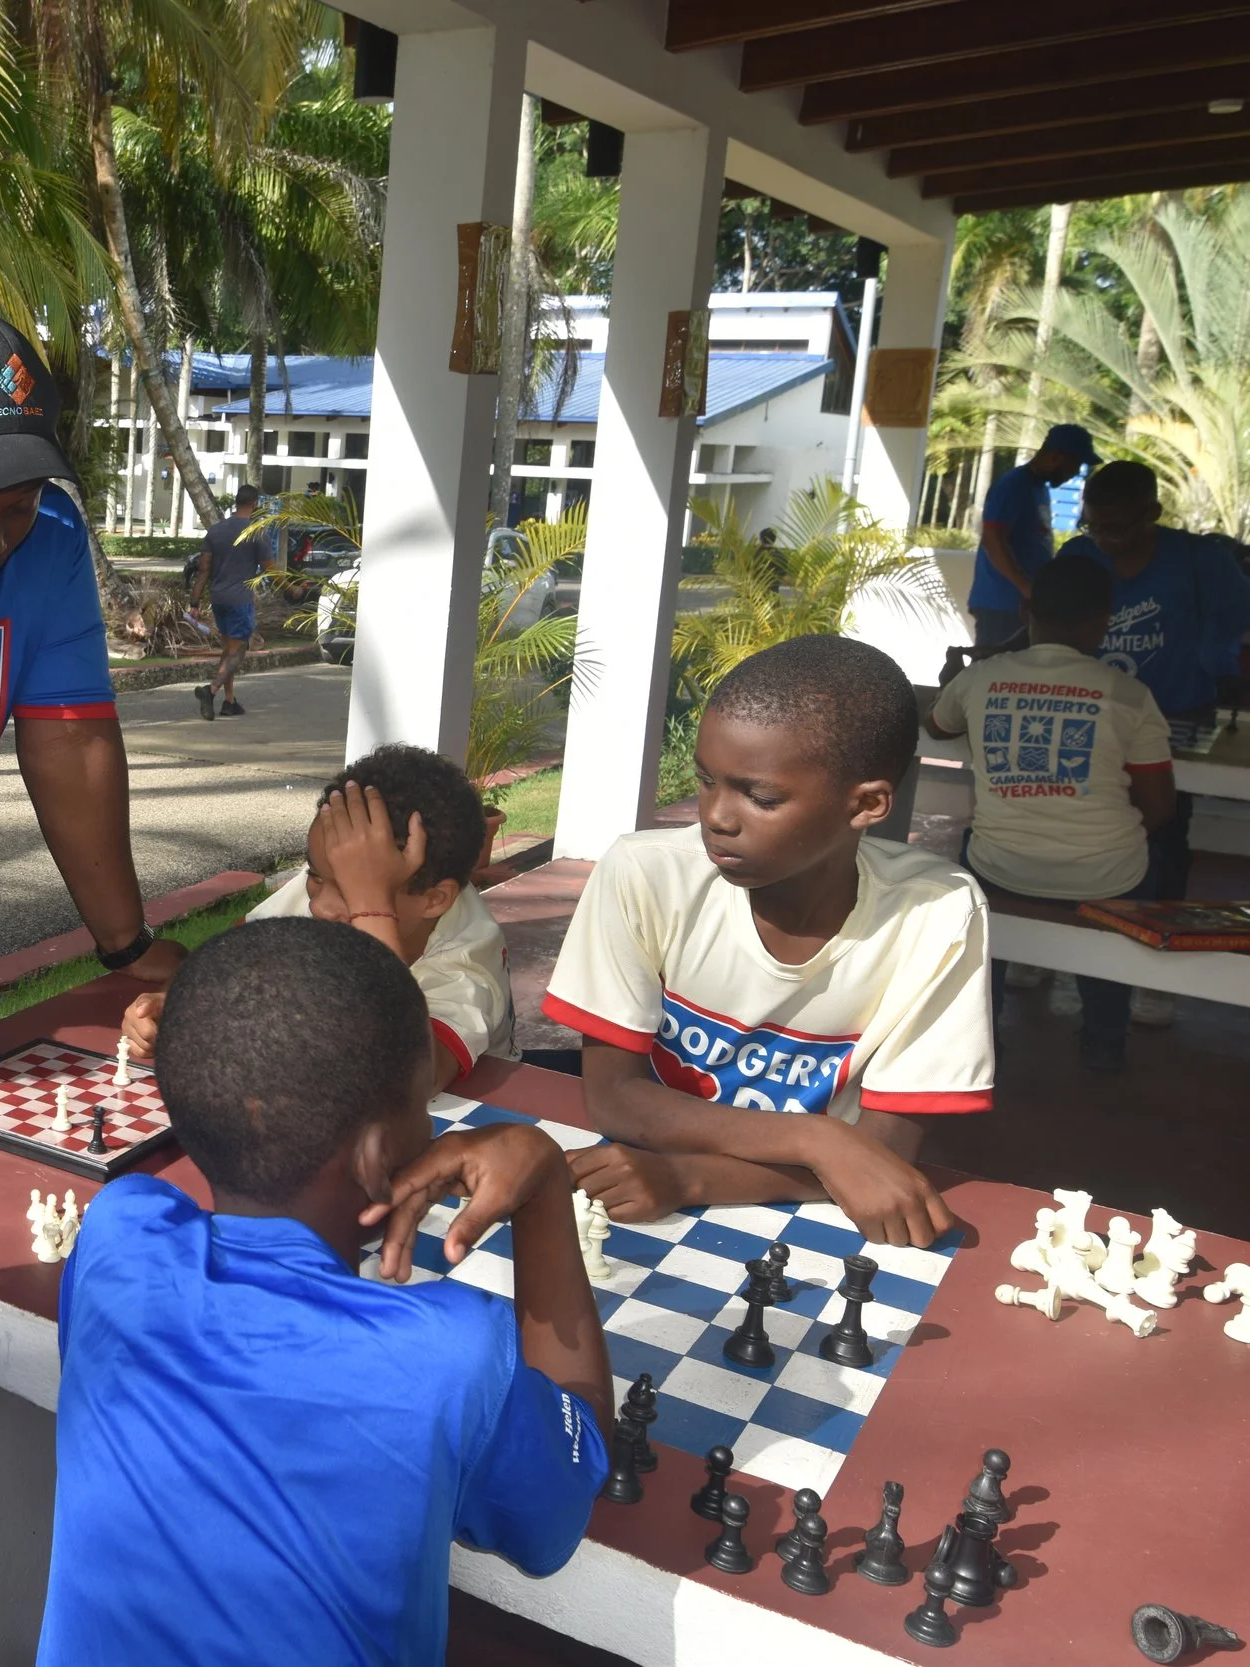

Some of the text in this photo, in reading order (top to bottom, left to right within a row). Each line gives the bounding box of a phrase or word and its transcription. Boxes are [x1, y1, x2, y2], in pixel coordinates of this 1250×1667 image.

[1107, 597, 1161, 632] odgers
[1099, 632, 1164, 652] AMTEAM
[988, 681, 1104, 699] APRENDIENDO
[985, 697, 1100, 715] ME DIVIERTO
[998, 784, 1077, 799] VERANO
[561, 1393, 573, 1437] Helen
